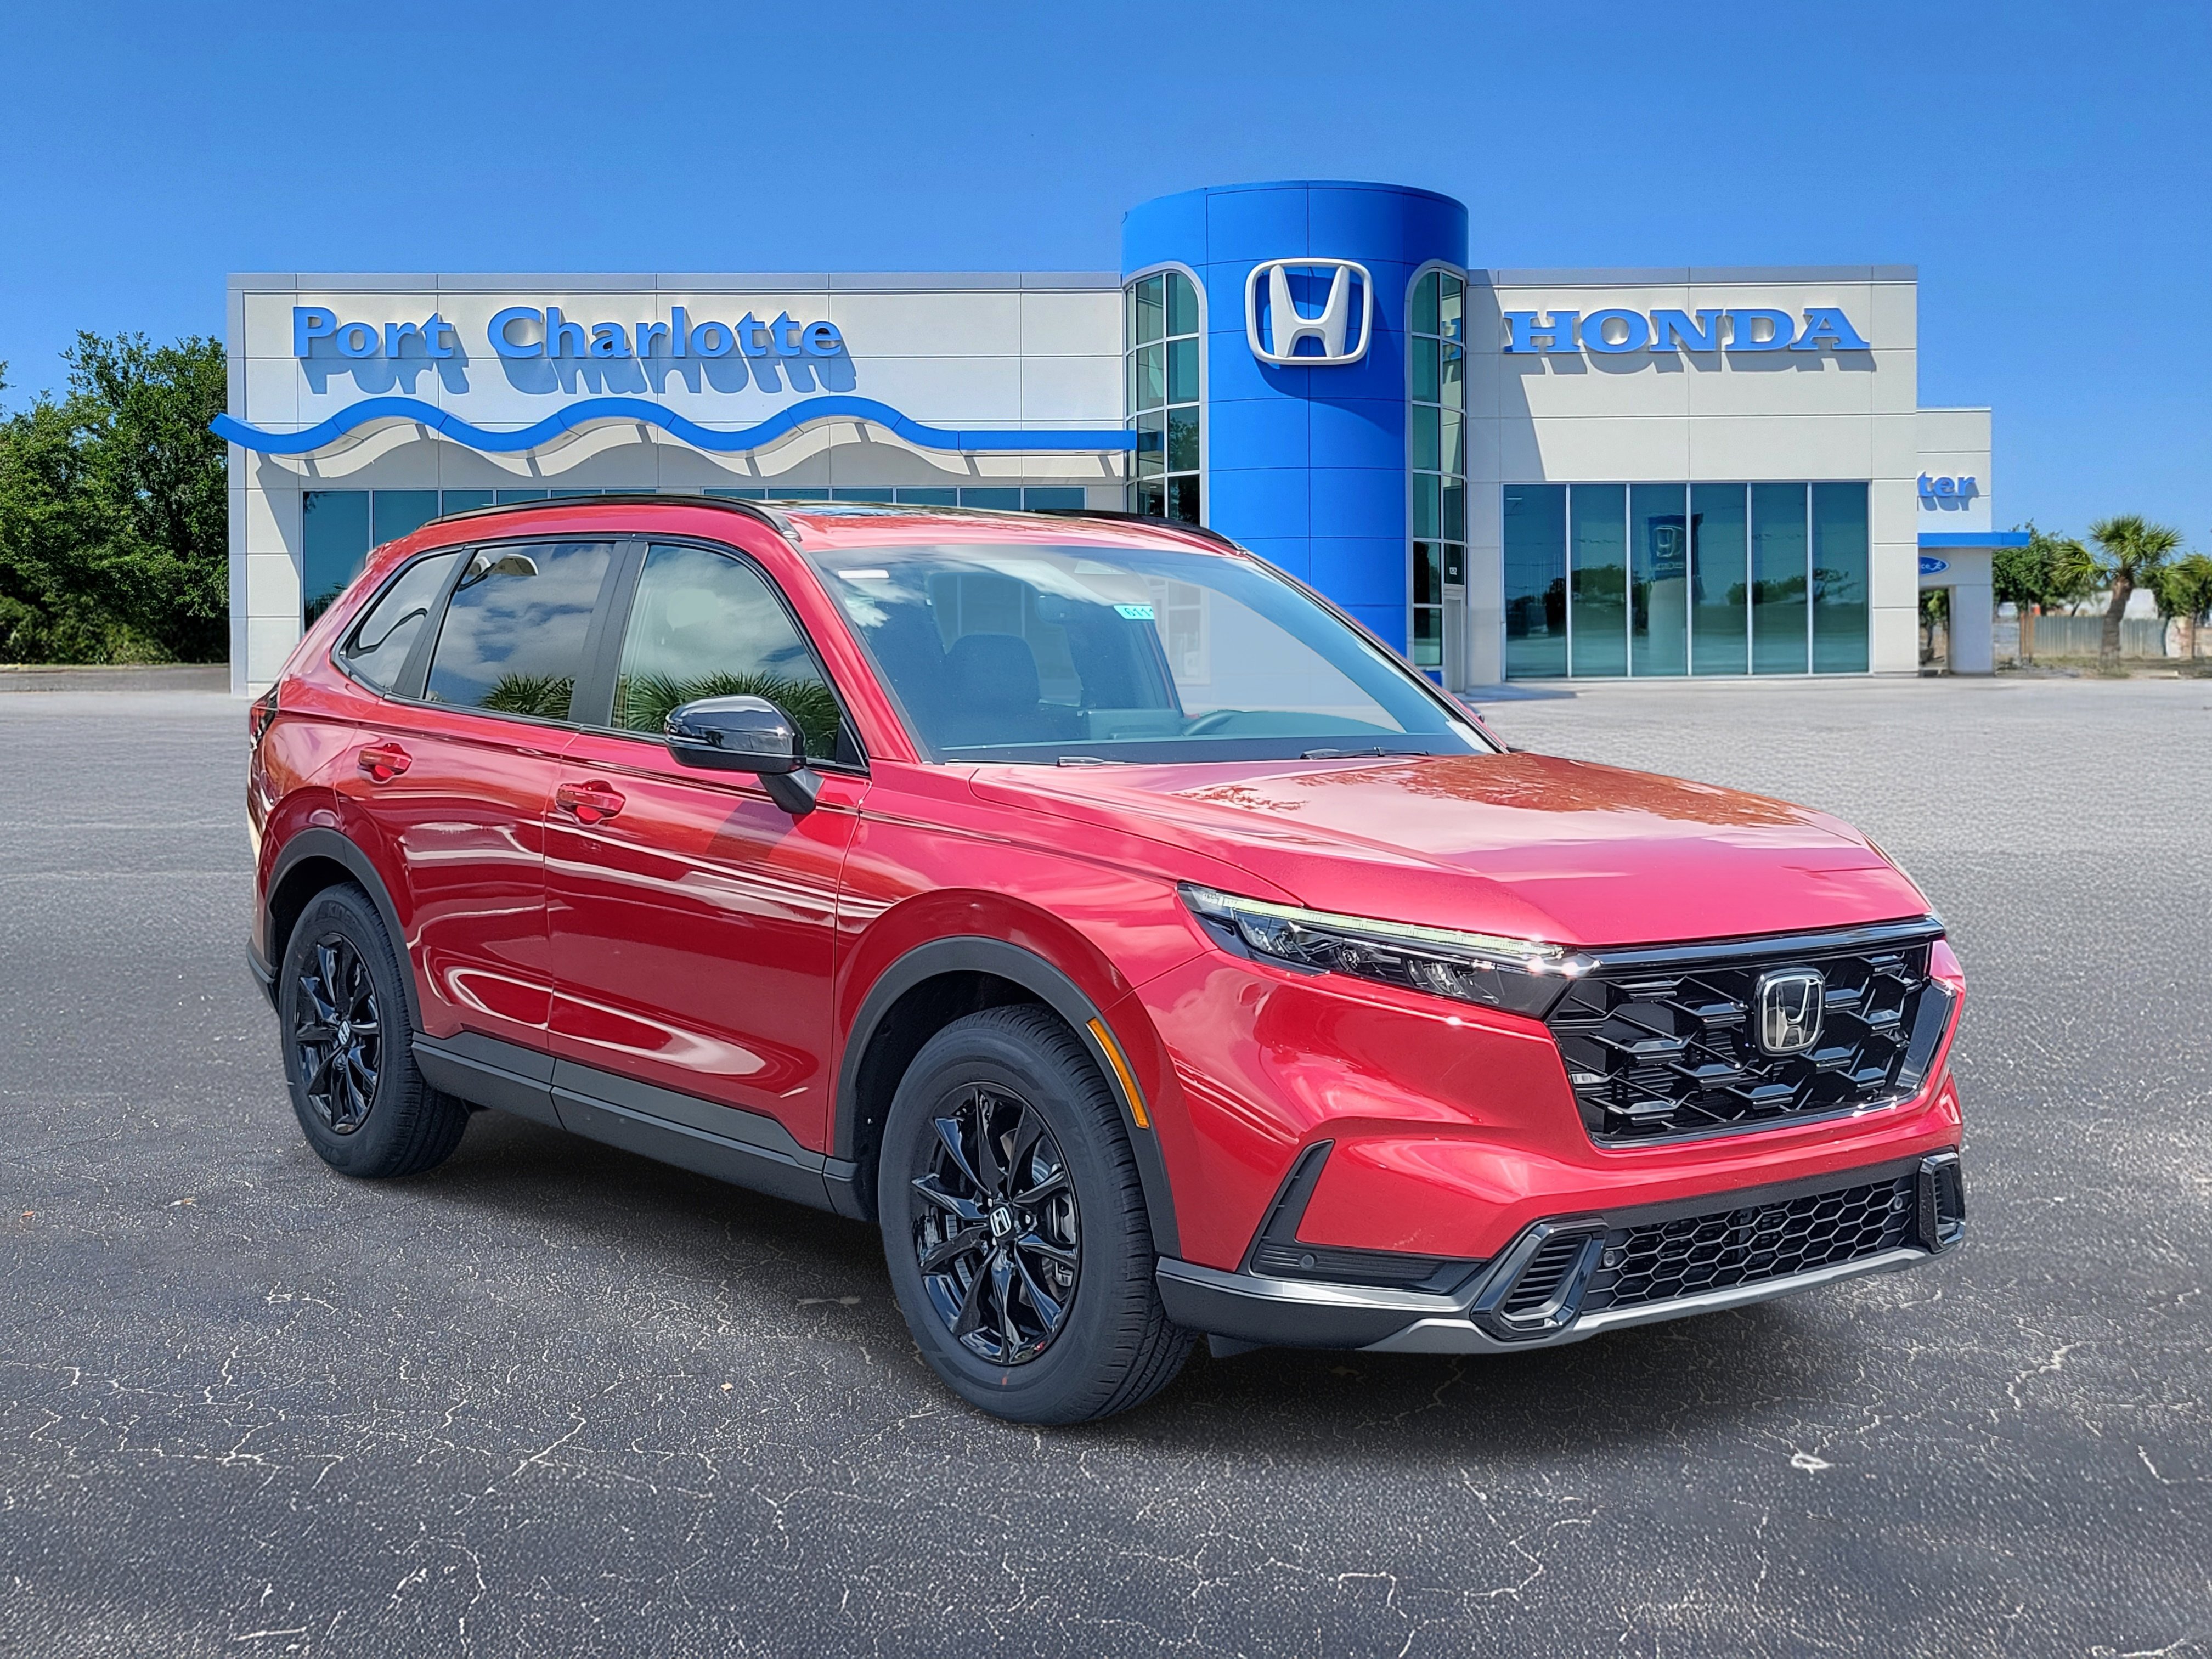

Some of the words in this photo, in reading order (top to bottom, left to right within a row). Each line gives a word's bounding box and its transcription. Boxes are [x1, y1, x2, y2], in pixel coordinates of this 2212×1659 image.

[292, 306, 453, 358] Port
[487, 306, 842, 357] Charlotte
[1263, 262, 1355, 360] H
[1504, 307, 1870, 353] HONDA
[1771, 978, 1814, 1048] H
